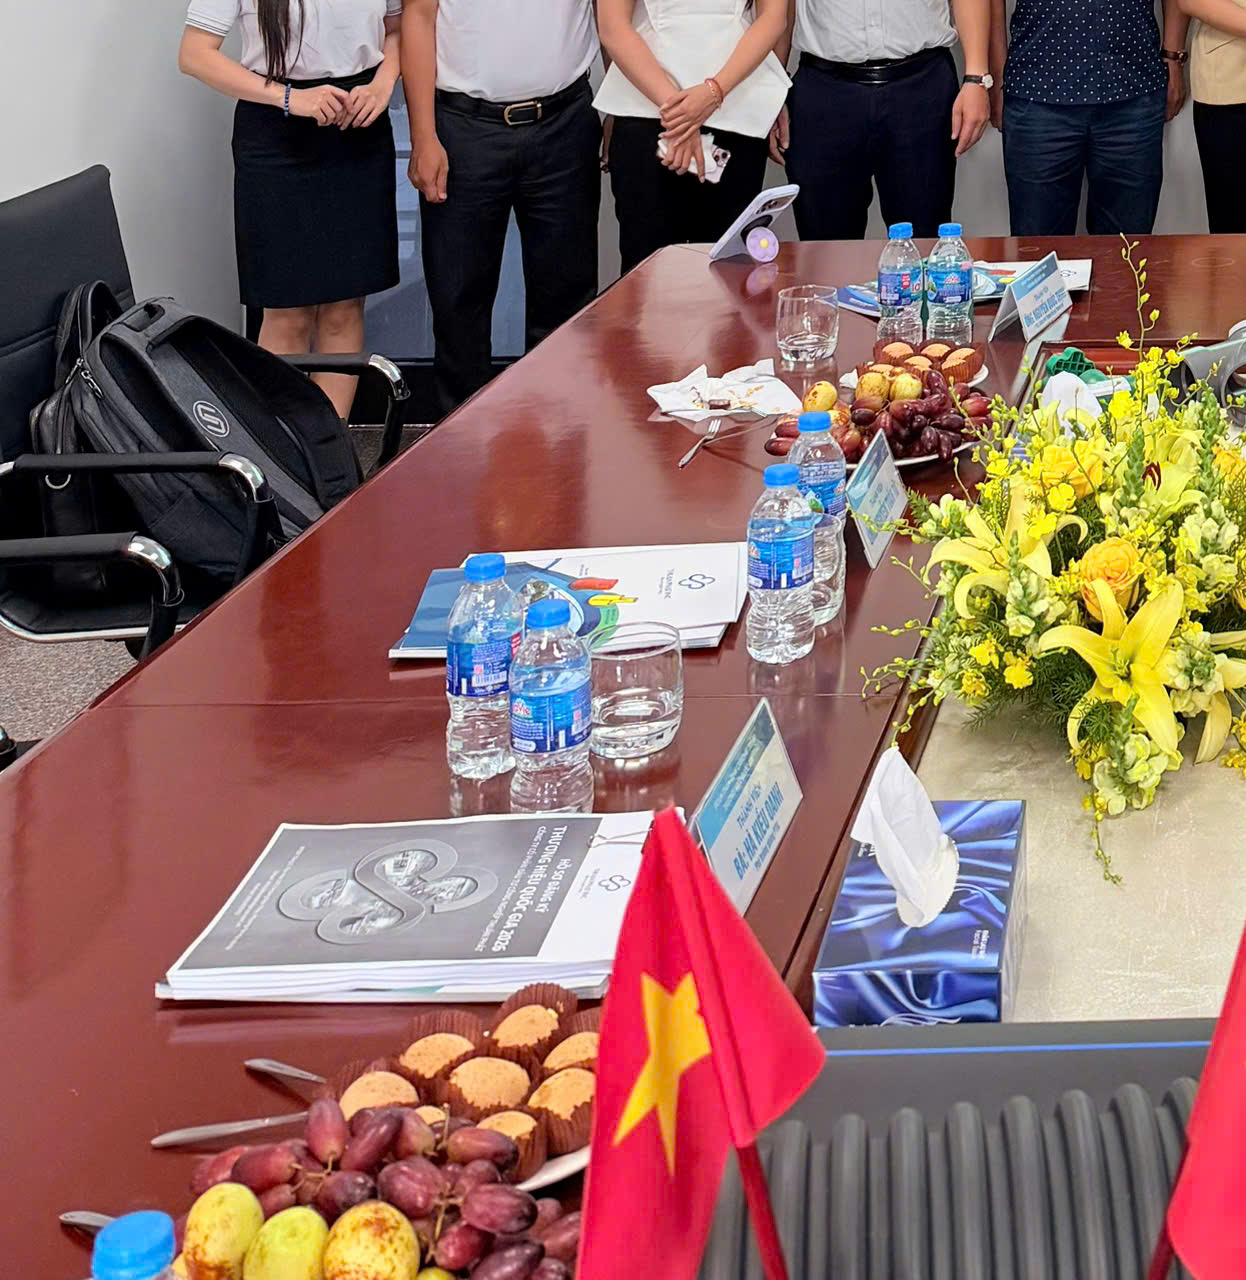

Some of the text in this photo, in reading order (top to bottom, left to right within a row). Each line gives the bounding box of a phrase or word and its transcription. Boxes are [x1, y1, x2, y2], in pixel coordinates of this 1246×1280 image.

[491, 825, 567, 952] THƯƠNG HIỆU QUỐC GIA 2026
[534, 858, 572, 913] HỒ SƠ ĐĂNG KÝ
